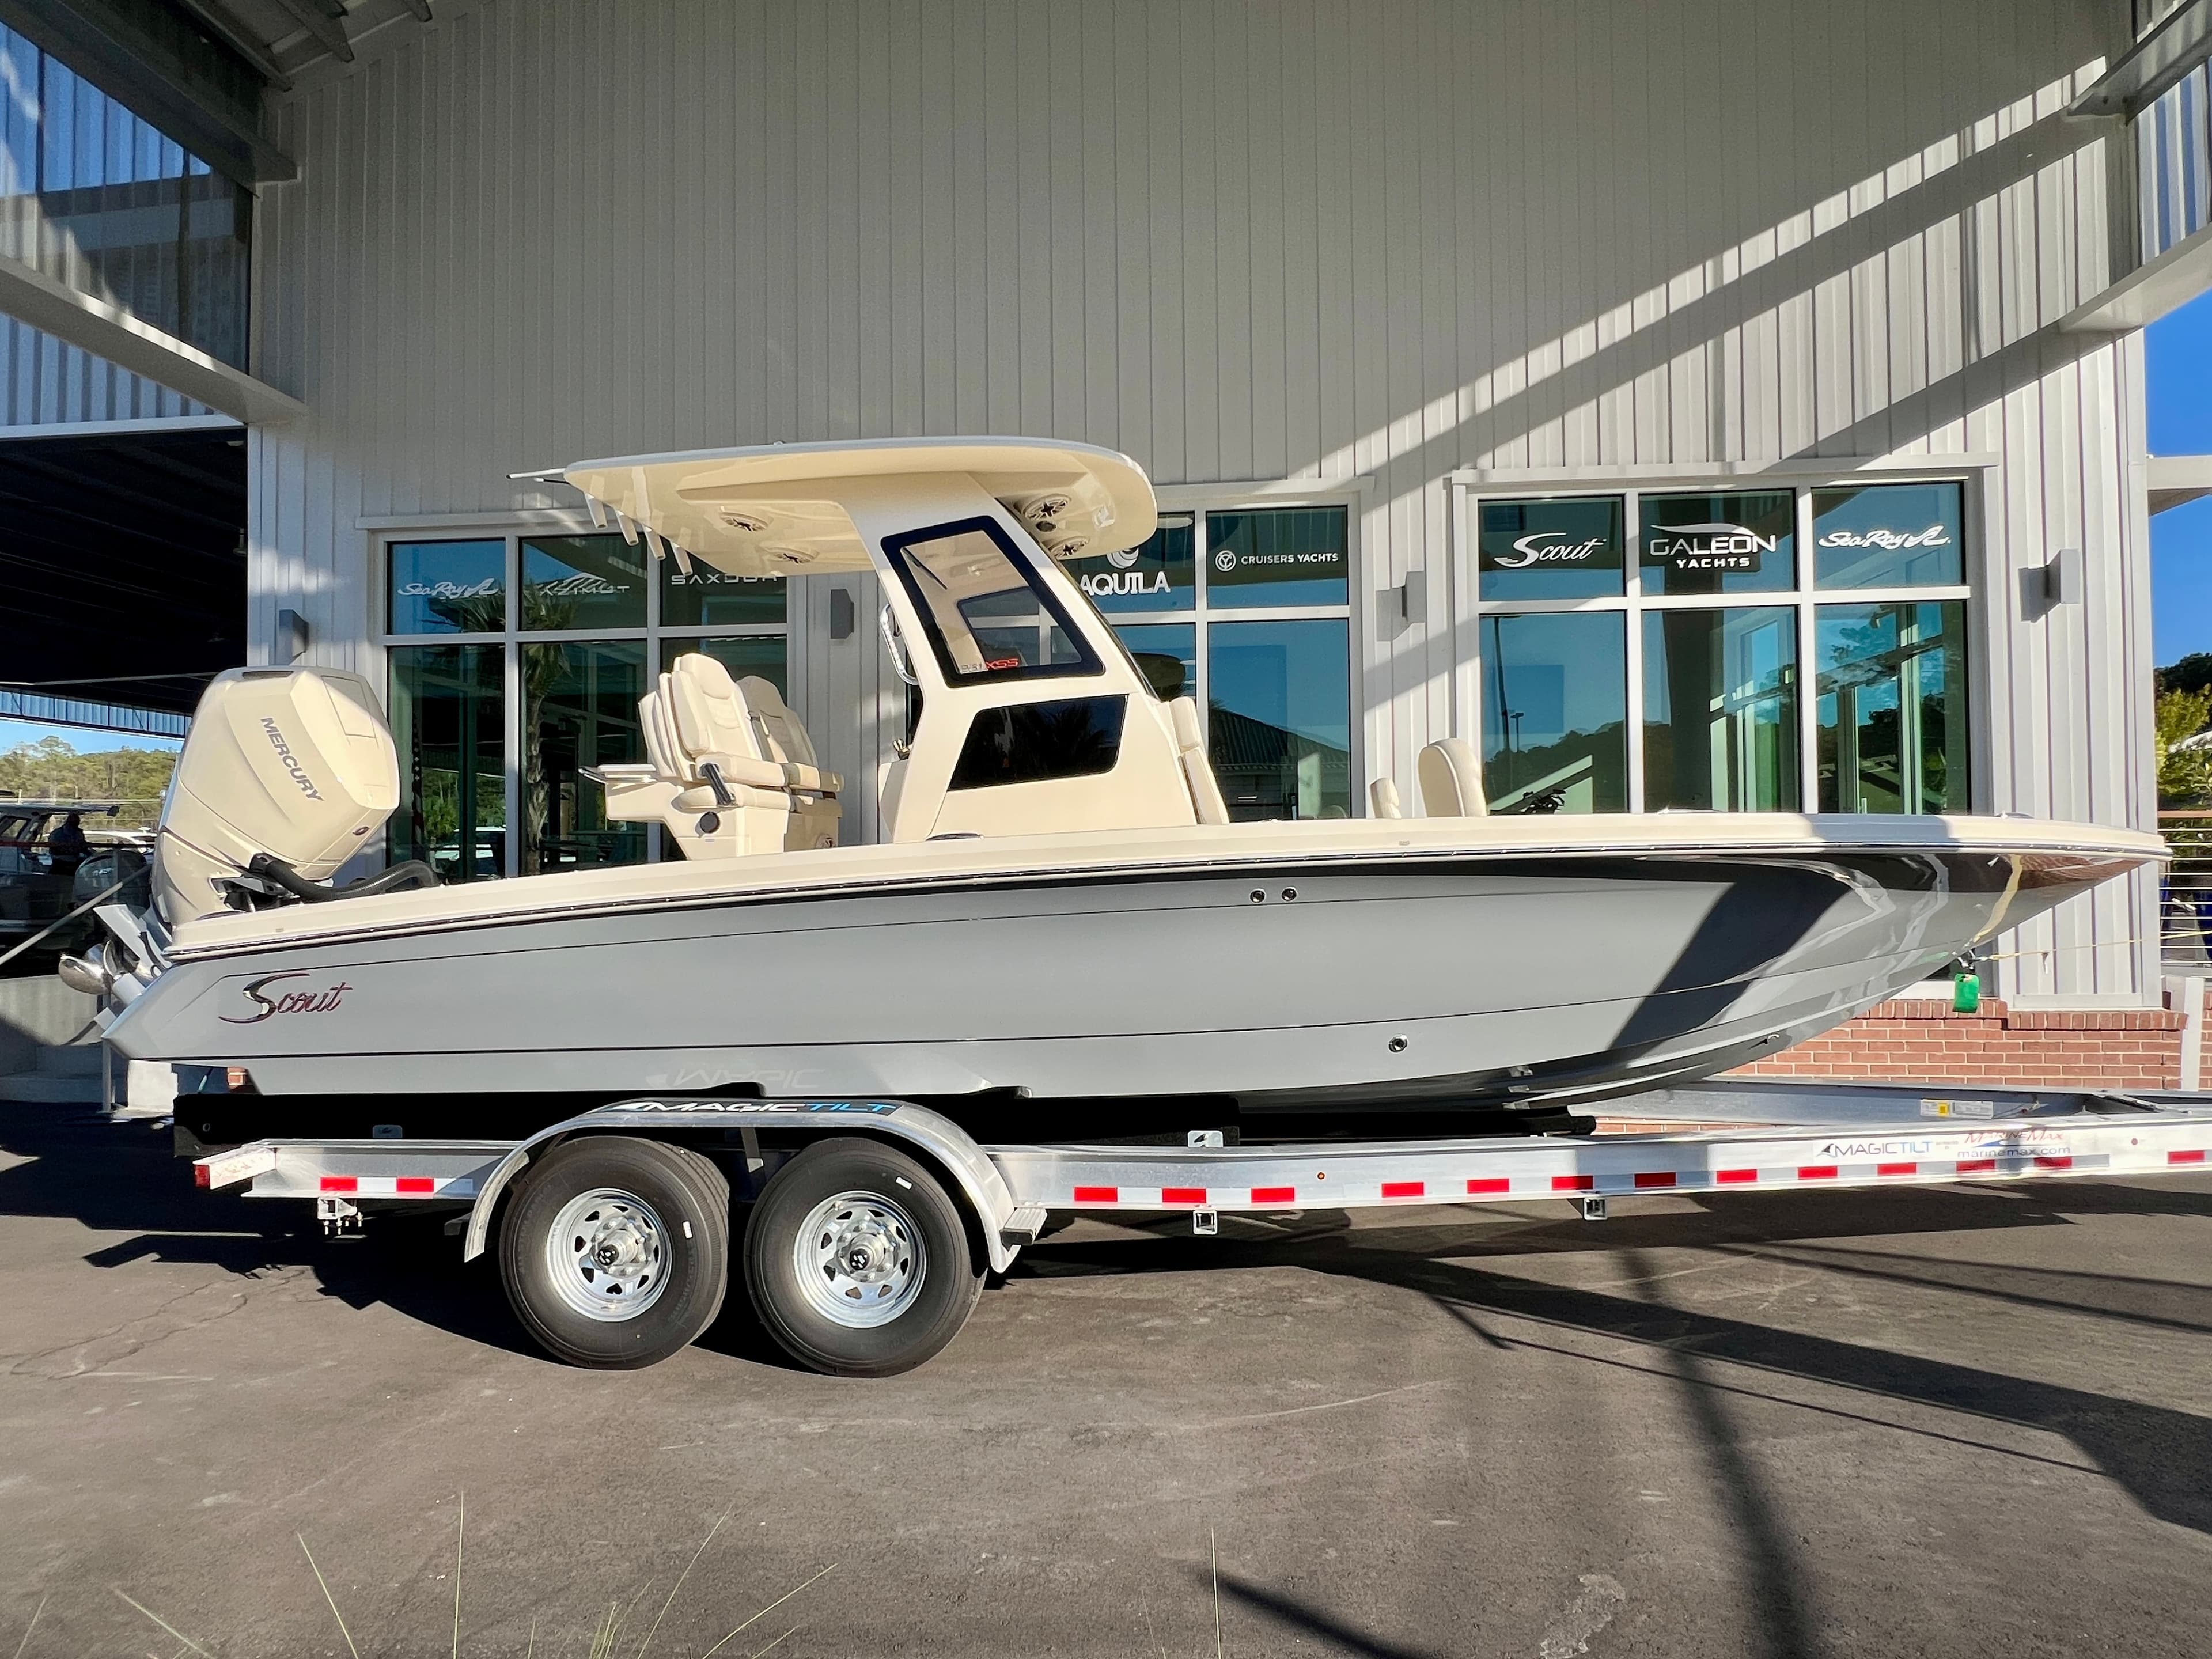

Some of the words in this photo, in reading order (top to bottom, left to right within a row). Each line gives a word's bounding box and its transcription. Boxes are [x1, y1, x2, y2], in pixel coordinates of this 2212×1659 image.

[1494, 532, 1604, 568] Scout
[1650, 534, 1777, 555] GALEON
[1241, 554, 1295, 565] CRUISERS
[1297, 552, 1340, 563] YACHTS
[1676, 557, 1751, 569] YACHTS
[1079, 571, 1171, 596] AQUILA
[986, 658, 1019, 671] XSS
[260, 717, 325, 801] MERCURY
[218, 972, 354, 1024] Scout
[641, 1101, 899, 1113] MAGICTILT
[1834, 1140, 1934, 1157] MAGICTILT
[1957, 1146, 2071, 1158] marinemax.com
